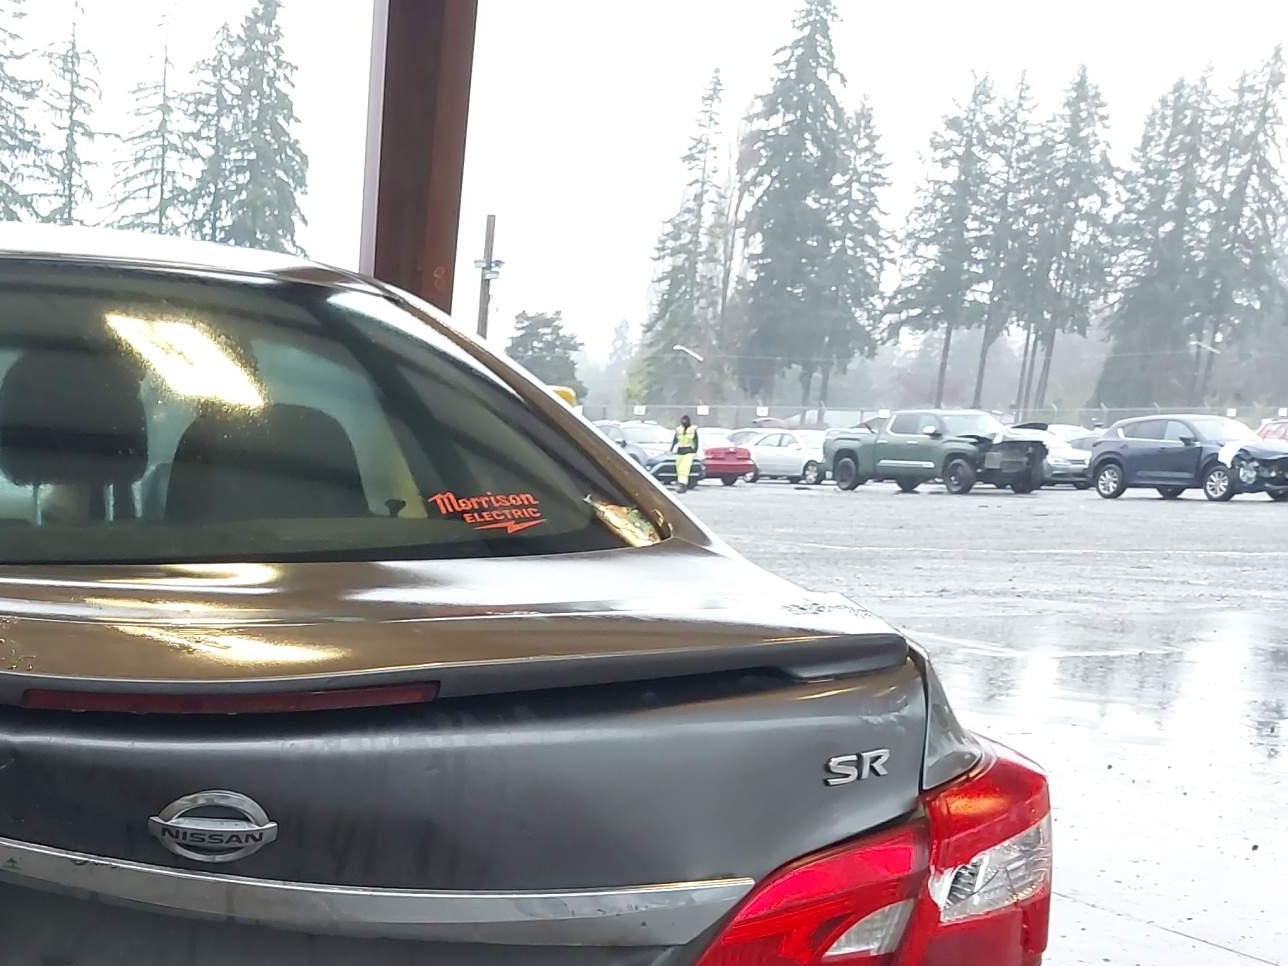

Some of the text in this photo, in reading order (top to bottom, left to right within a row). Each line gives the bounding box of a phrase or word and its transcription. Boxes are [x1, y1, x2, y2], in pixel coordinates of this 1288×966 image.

[428, 491, 540, 515] Morrison
[463, 507, 542, 523] ELECTRIC
[824, 748, 890, 786] SR
[161, 827, 264, 844] NISSAN
